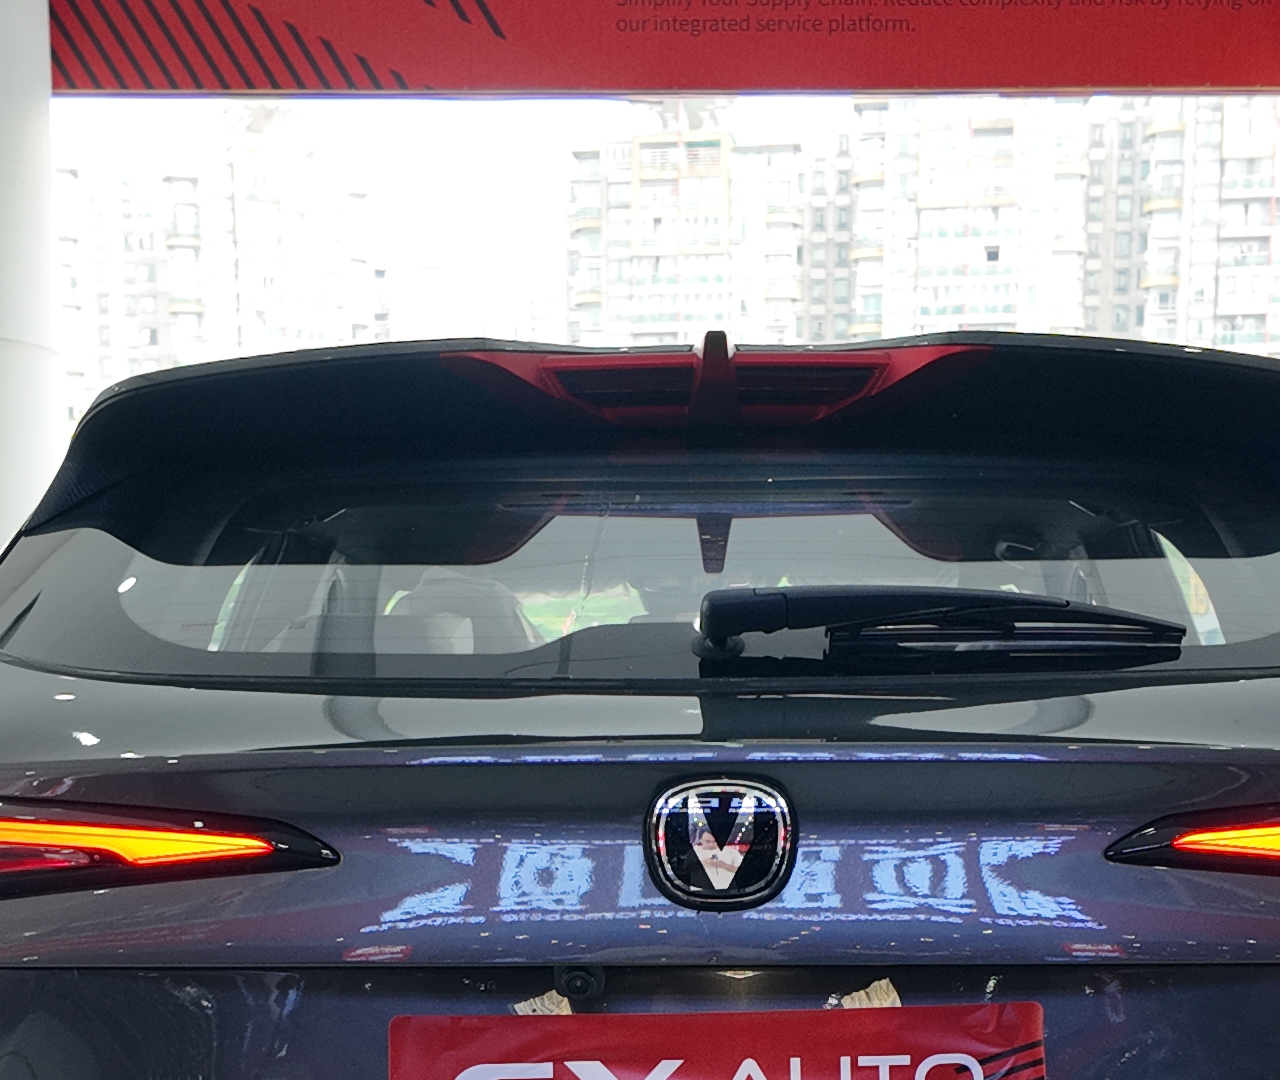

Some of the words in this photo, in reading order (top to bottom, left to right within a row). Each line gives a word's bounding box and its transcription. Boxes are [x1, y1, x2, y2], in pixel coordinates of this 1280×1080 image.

[615, 18, 649, 32] our
[653, 15, 751, 37] integrated
[756, 15, 822, 32] service
[828, 15, 916, 36] platform.
